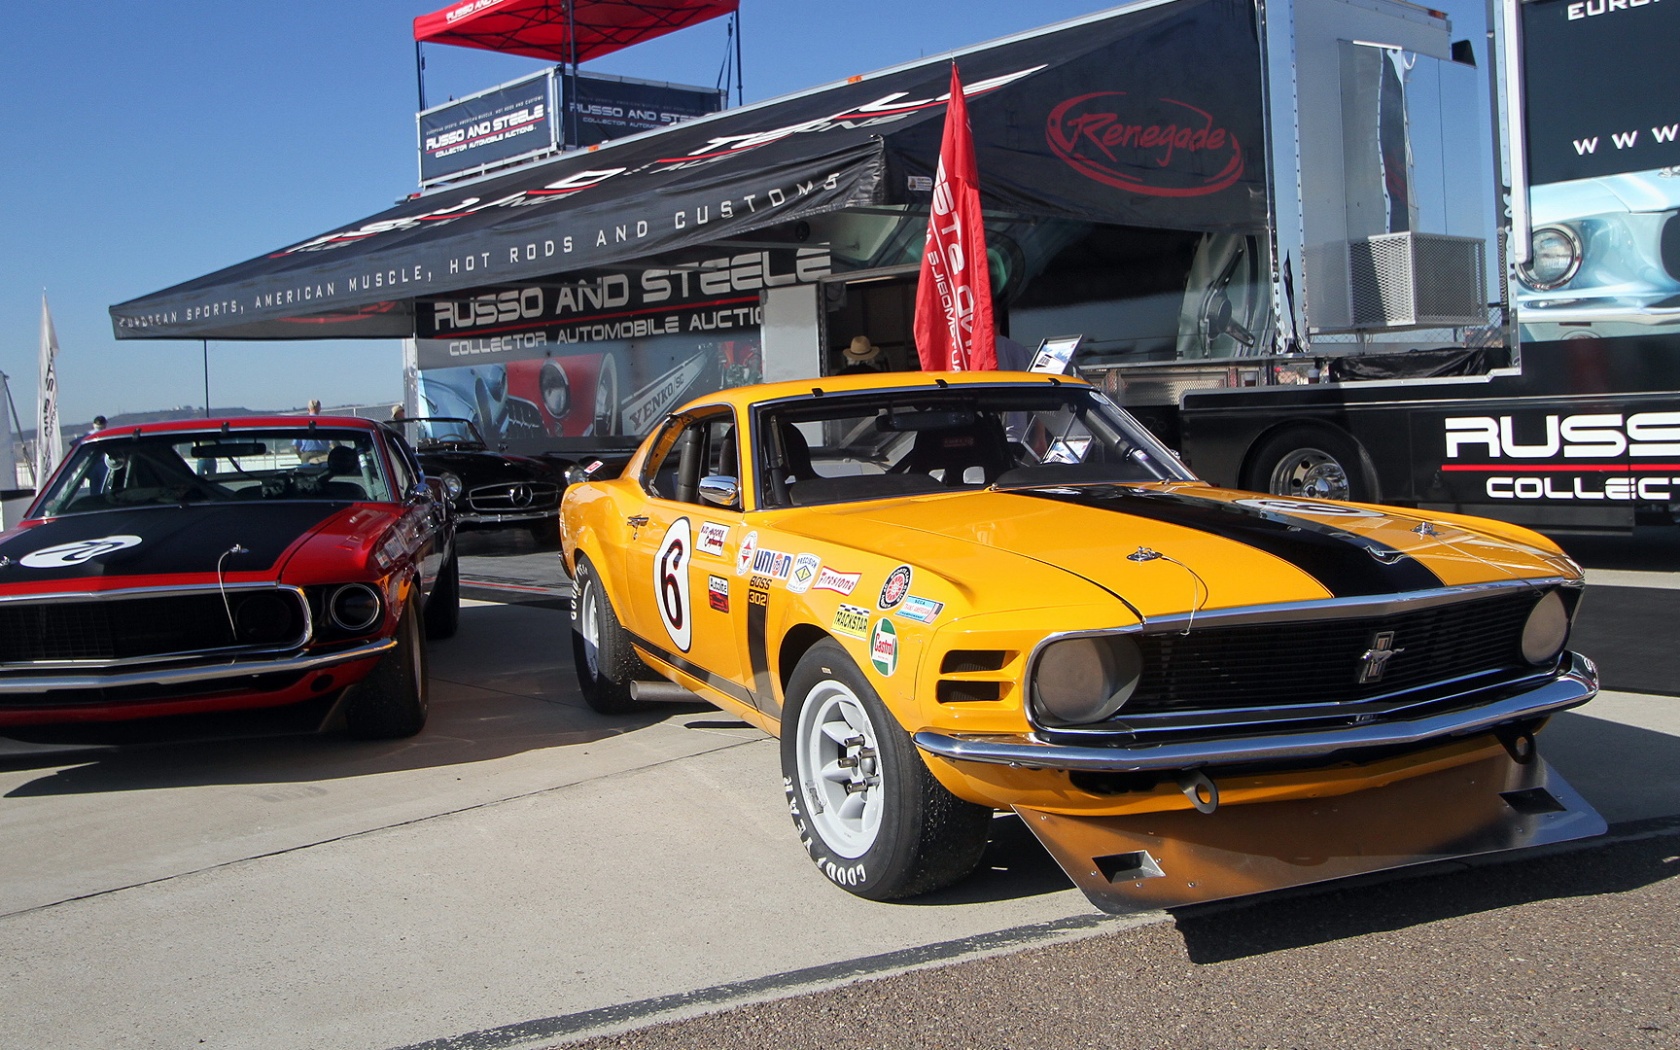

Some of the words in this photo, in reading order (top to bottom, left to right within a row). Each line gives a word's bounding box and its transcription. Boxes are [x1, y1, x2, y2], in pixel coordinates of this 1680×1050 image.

[569, 102, 623, 117] RUSSO
[627, 109, 657, 121] AND
[426, 129, 464, 150] RUSSO
[467, 121, 491, 139] AND
[493, 104, 544, 131] STEELE
[1067, 111, 1226, 168] Renegade
[255, 282, 335, 309] AMERICAN
[349, 265, 432, 292] MUSCLE,
[450, 252, 491, 274] HOT
[510, 235, 574, 263] RODS
[597, 220, 648, 247] AND
[675, 173, 840, 230] CUSTOMS
[434, 287, 544, 331] RUSSO
[555, 274, 630, 315] AND
[641, 241, 832, 304] STEELE
[450, 330, 548, 357] COLLECTOR
[557, 315, 680, 346] AUTOMOBILE
[1445, 411, 1680, 458] RUSS
[1486, 476, 1680, 500] COLLEC
[753, 550, 792, 578] UNION
[661, 538, 684, 631] 6
[749, 575, 773, 590] BOSS
[820, 572, 855, 591] Firestone
[748, 591, 768, 607] 302
[834, 611, 868, 633] TRACKSTAR
[874, 633, 896, 656] Castrol
